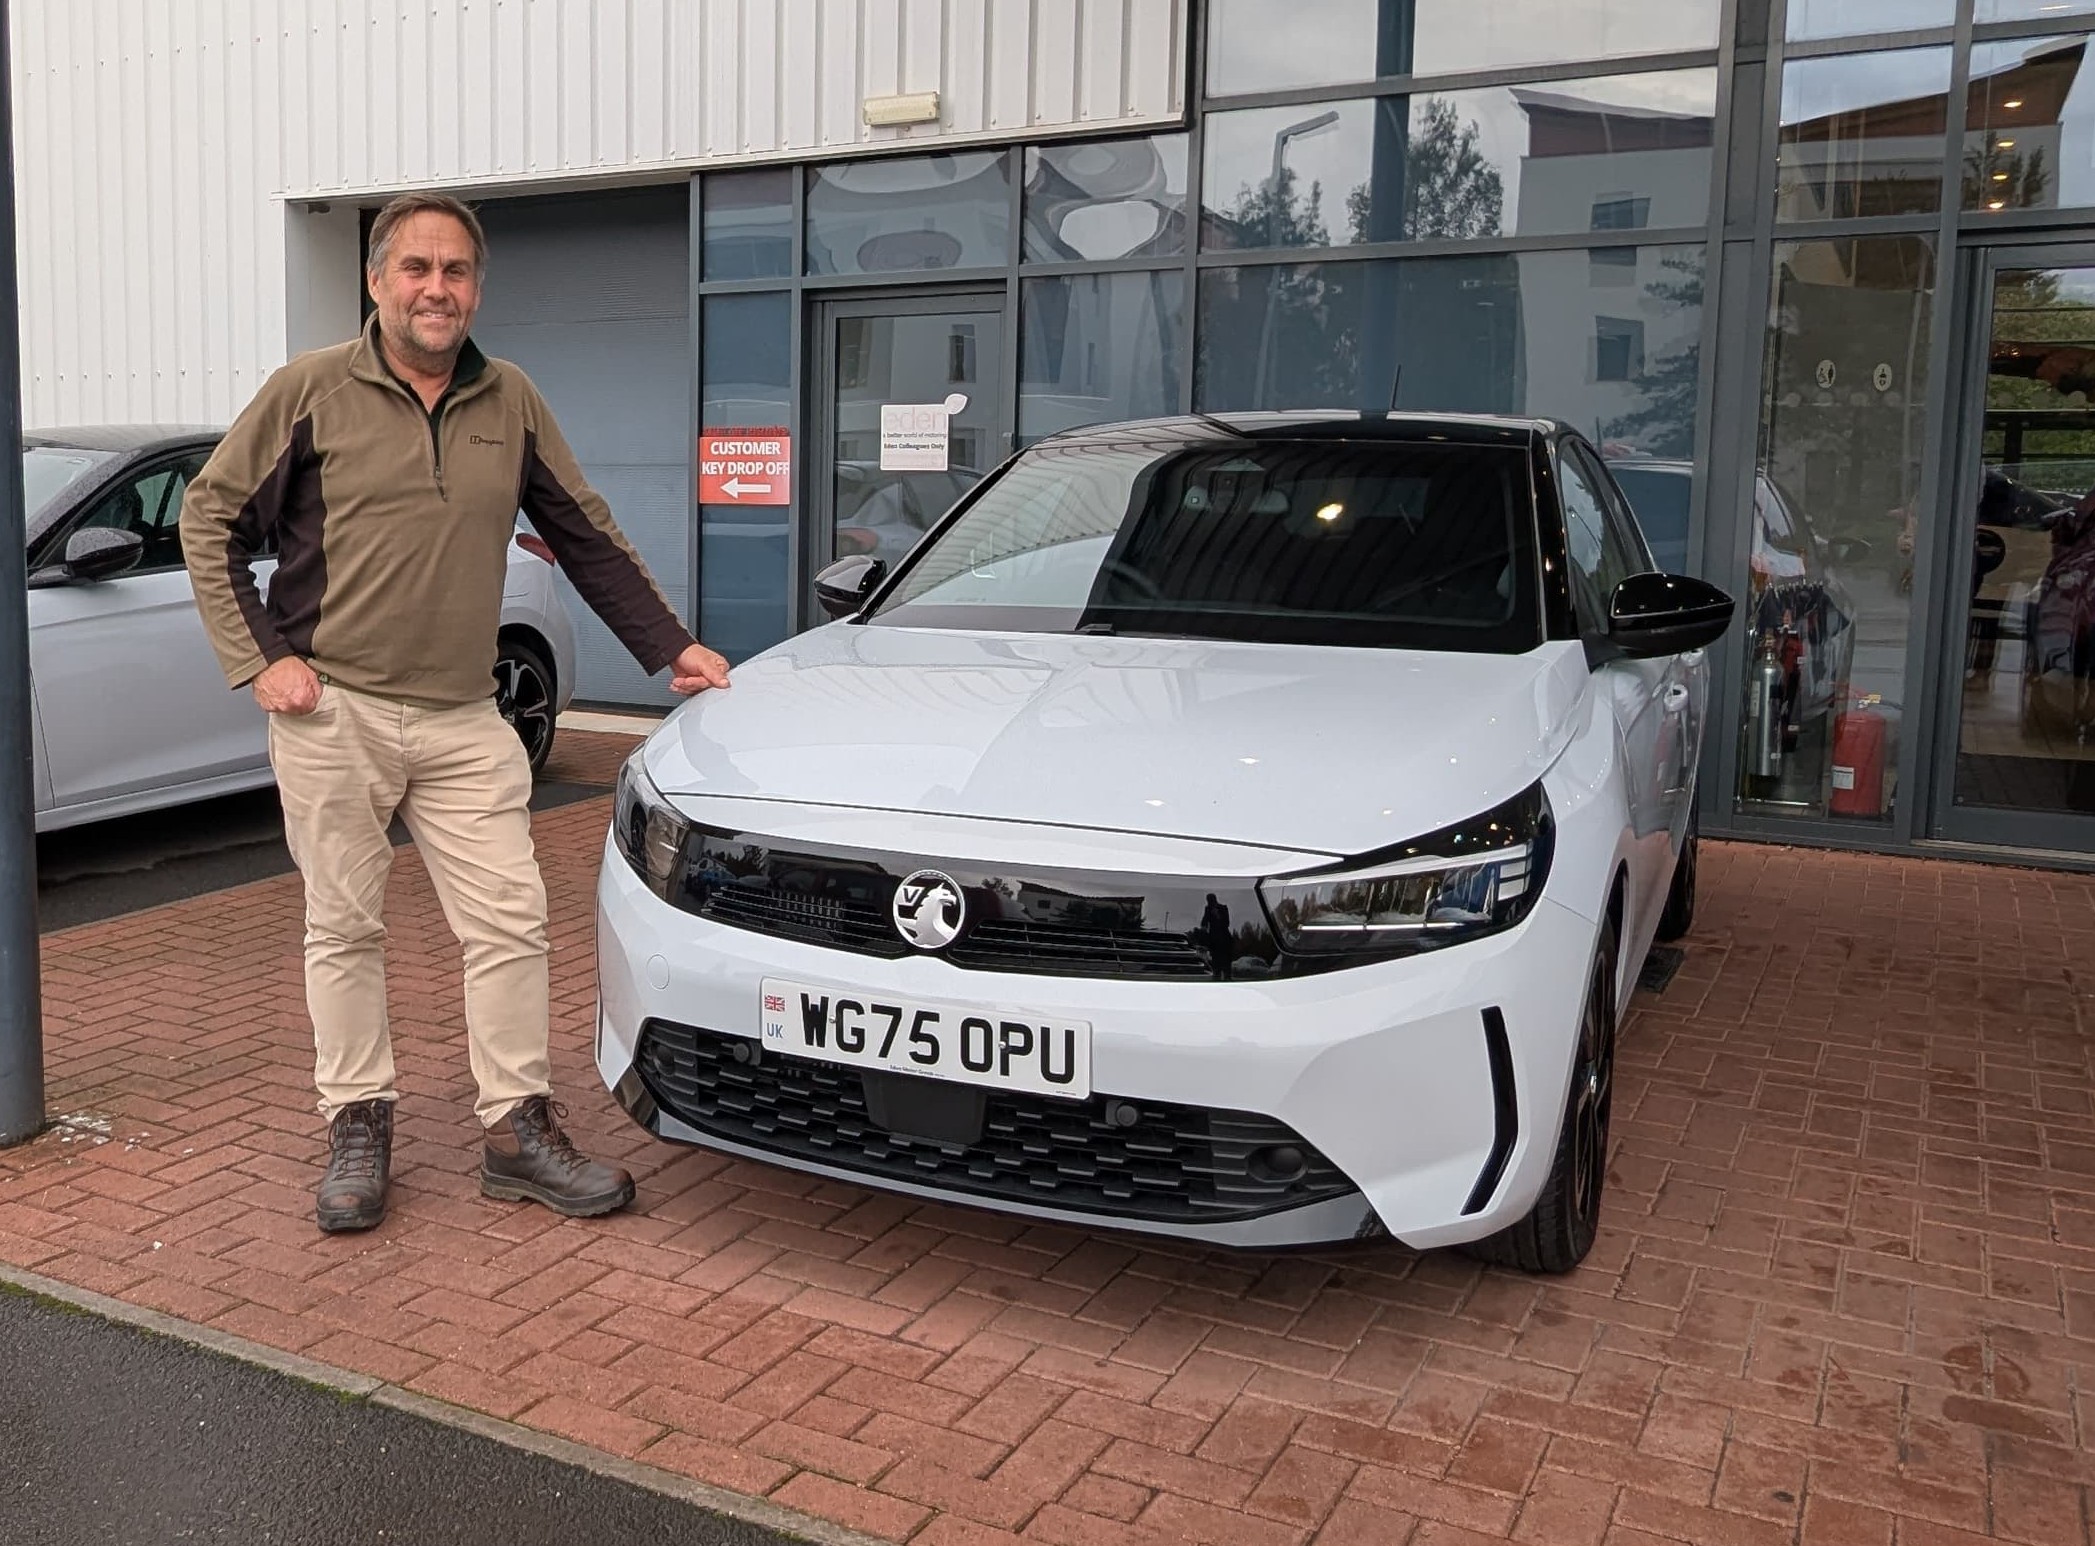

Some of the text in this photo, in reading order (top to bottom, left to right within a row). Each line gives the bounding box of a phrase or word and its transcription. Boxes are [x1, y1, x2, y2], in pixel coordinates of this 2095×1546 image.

[710, 441, 781, 455] CUSTOMER
[701, 461, 726, 475] KEY
[727, 461, 764, 475] DROP
[766, 1022, 784, 1039] UK
[799, 992, 1075, 1085] WG75 OPU
